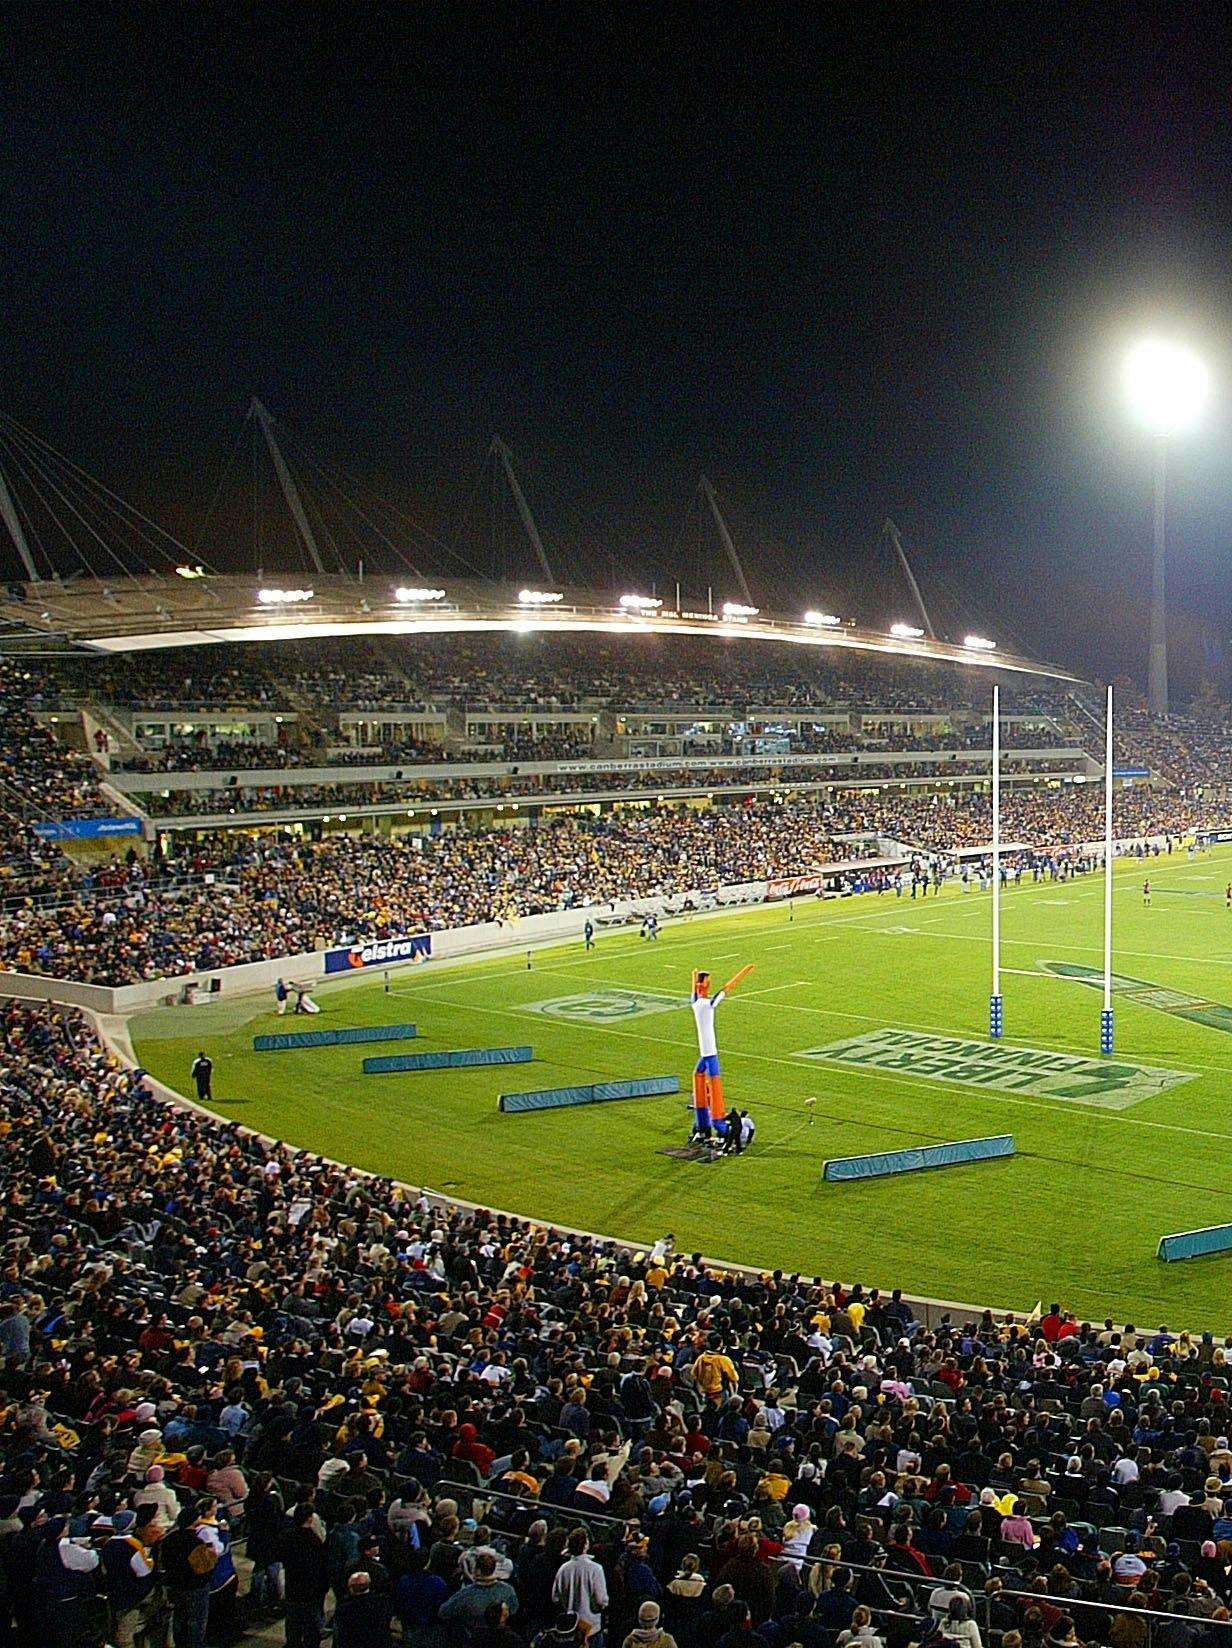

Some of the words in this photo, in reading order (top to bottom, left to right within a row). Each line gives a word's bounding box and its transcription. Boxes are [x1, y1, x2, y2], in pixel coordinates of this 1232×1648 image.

[349, 941, 412, 967] Telstra
[806, 1043, 1048, 1089] LIBERTY
[870, 1031, 1089, 1073] FINANCIAL
